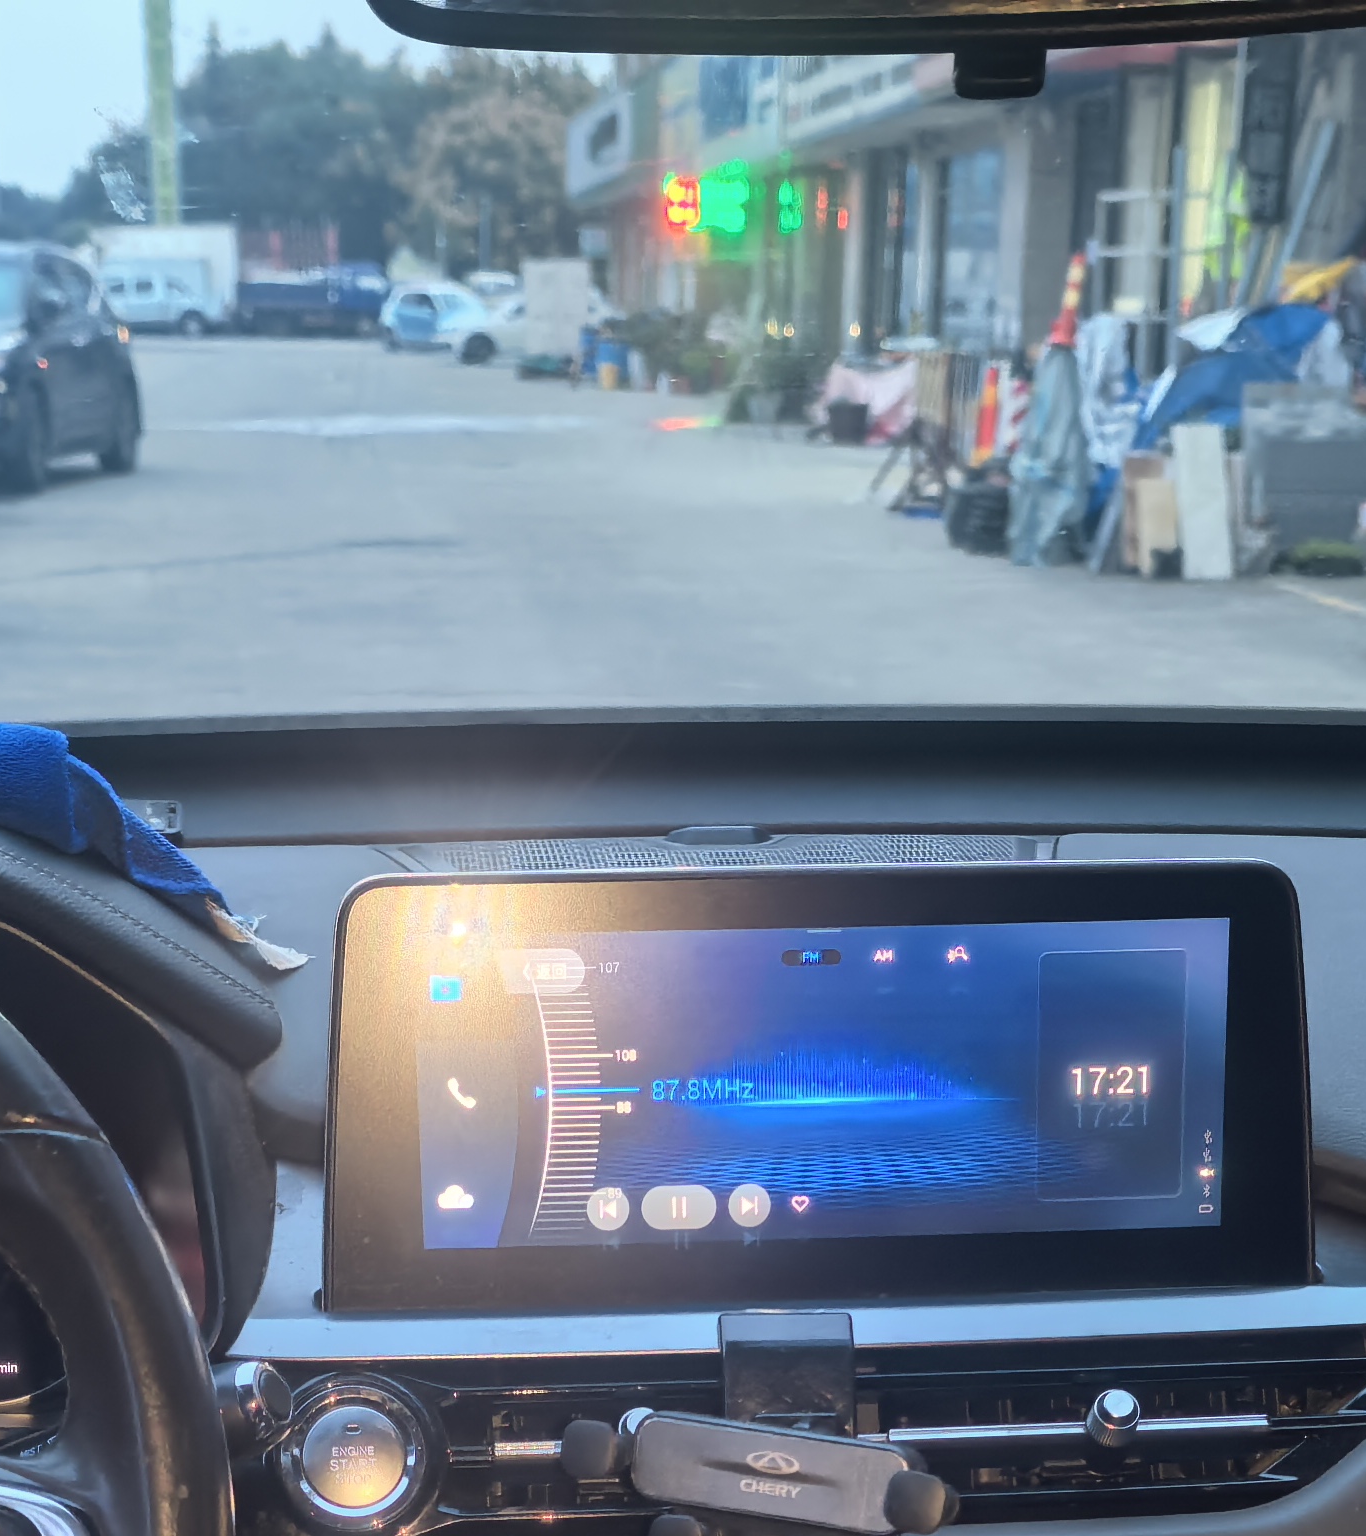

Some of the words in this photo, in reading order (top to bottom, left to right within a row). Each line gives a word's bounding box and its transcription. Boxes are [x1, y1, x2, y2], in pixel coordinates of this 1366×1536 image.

[802, 951, 820, 964] FM
[873, 950, 893, 963] AM
[599, 961, 620, 974] 107
[1072, 1066, 1148, 1096] 17:21
[651, 1079, 755, 1101] 87.8MHz
[607, 1188, 623, 1199] 89
[332, 1445, 375, 1457] ENGINE
[330, 1458, 377, 1472] START
[739, 1479, 802, 1499] CHERY
